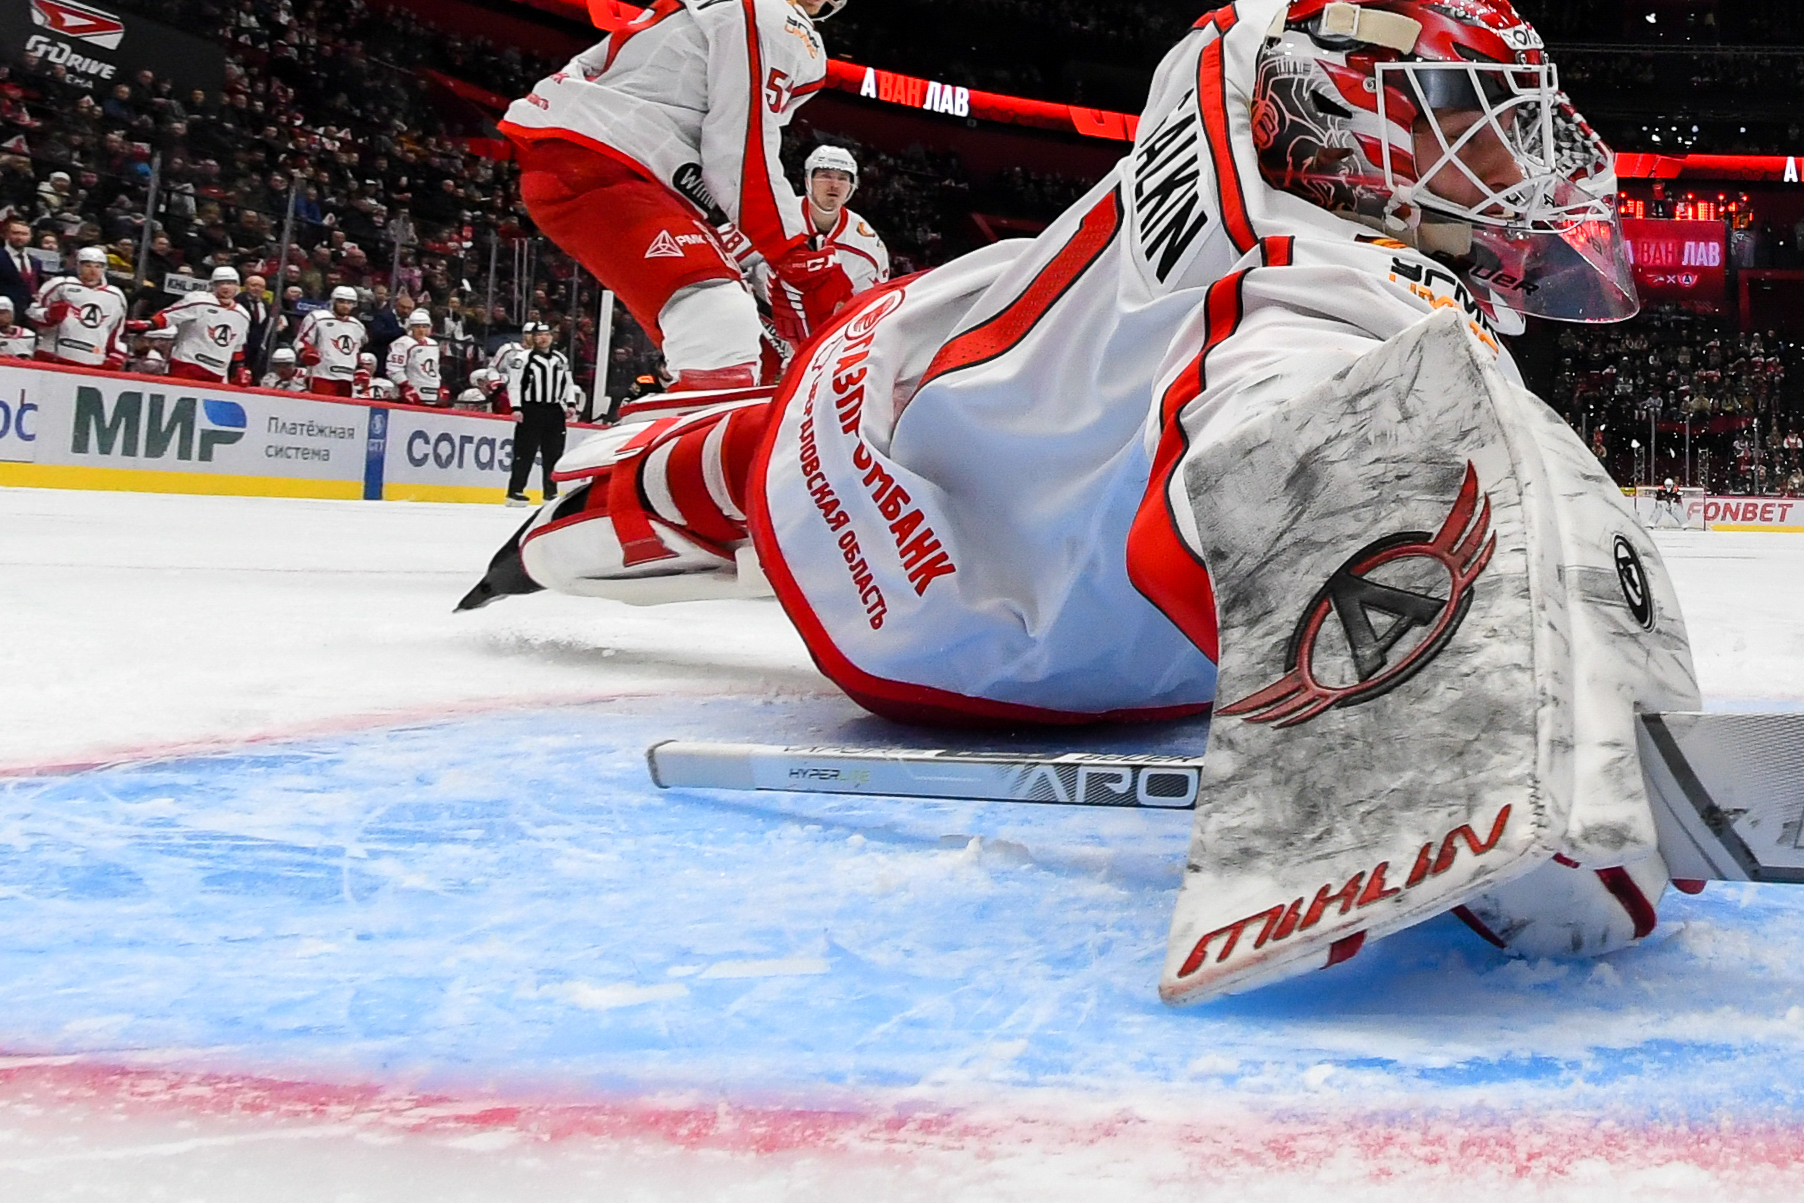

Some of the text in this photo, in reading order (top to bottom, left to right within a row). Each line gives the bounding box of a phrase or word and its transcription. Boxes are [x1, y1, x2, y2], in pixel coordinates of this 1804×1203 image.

[860, 67, 970, 118] А ВАН ЛАВ
[1783, 157, 1799, 184] А
[1681, 240, 1721, 267] ЛАВ
[71, 385, 248, 462] МИР
[267, 416, 355, 440] Платёжная
[265, 443, 331, 462] система
[407, 429, 515, 472] согаз
[1687, 501, 1794, 523] FONBET
[838, 521, 889, 631] ОБЛАСТЬ
[788, 766, 870, 785] HYPERLITE
